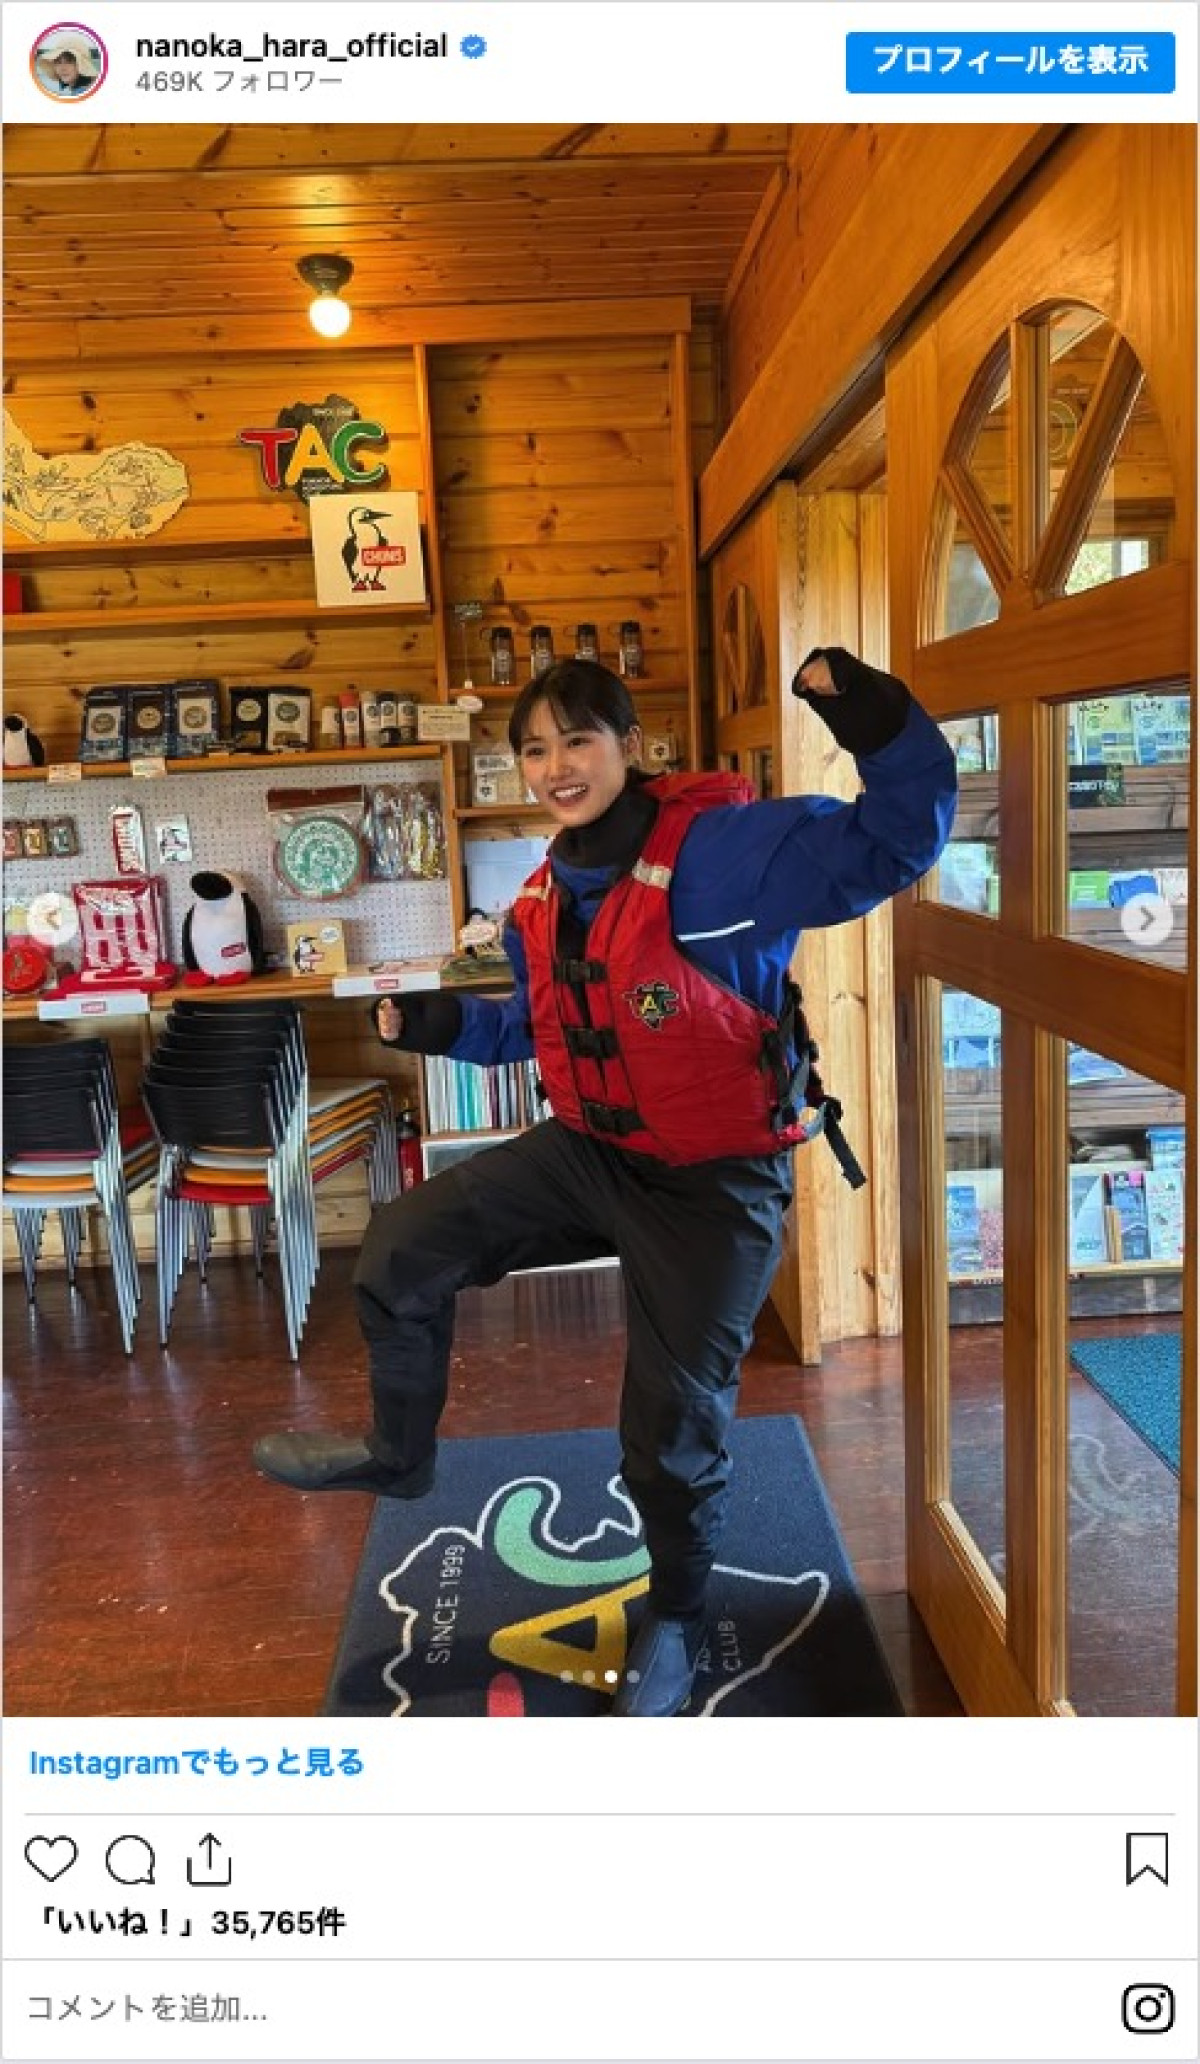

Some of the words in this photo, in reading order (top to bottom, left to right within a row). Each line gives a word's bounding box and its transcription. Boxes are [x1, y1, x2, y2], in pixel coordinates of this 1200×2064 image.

[239, 420, 386, 489] TAC
[439, 1544, 467, 1588] 1999
[425, 1593, 459, 1664] SINCE
[487, 1487, 653, 1717] AC
